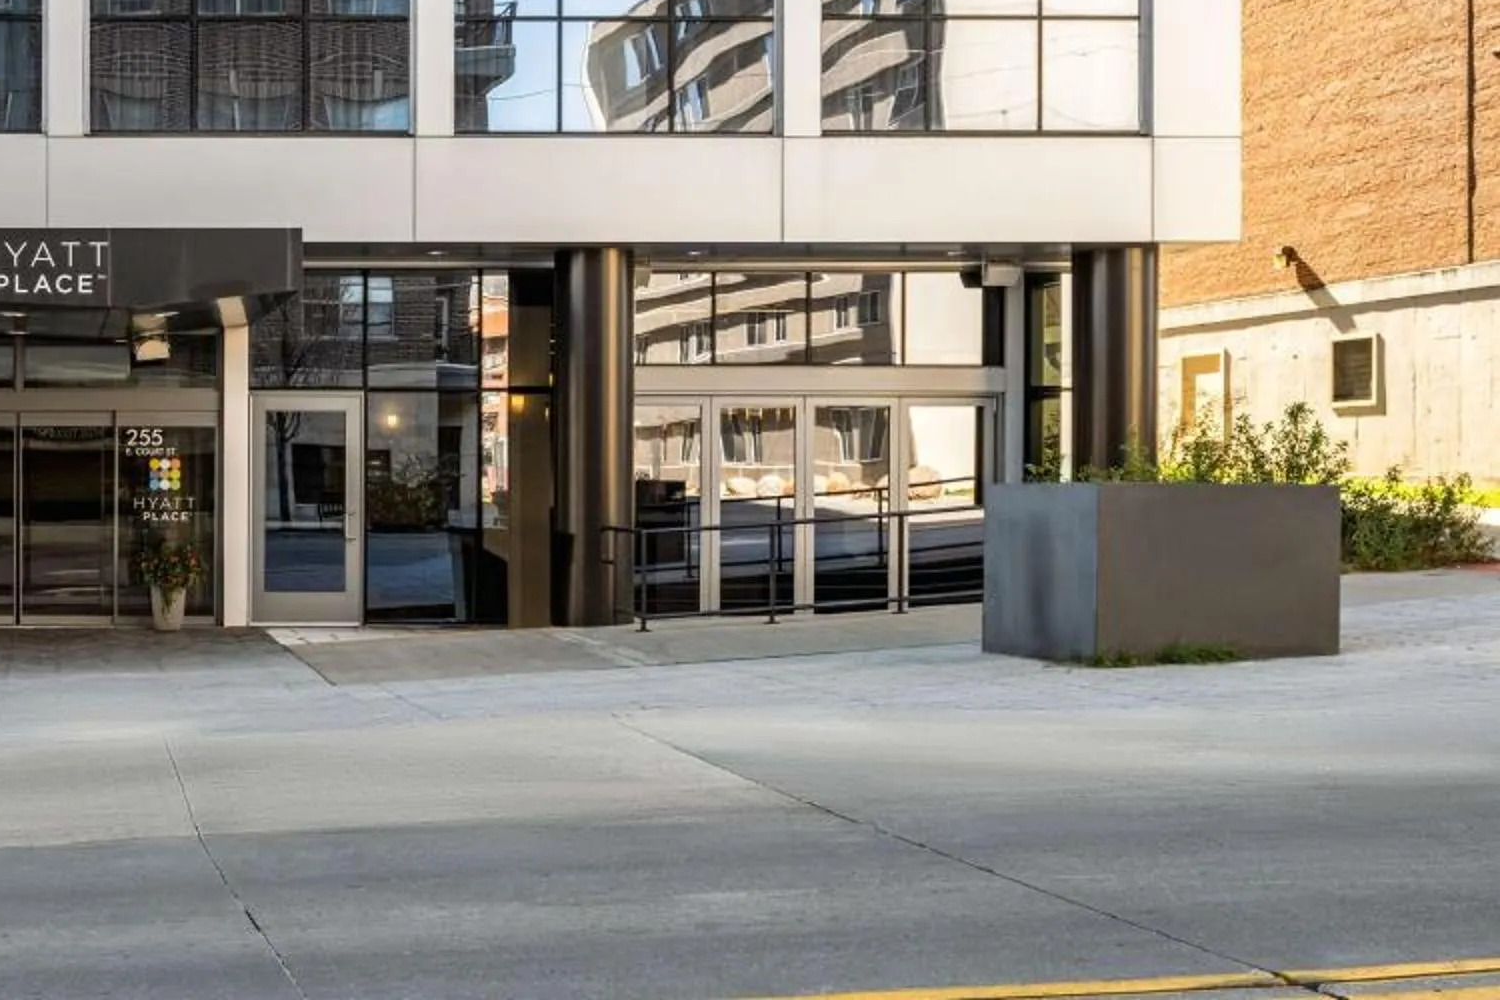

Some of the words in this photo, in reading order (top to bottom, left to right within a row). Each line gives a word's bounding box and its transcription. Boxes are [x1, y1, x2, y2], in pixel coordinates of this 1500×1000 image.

[126, 429, 163, 446] 255
[133, 497, 195, 509] HYATT
[143, 511, 190, 521] PLACE
